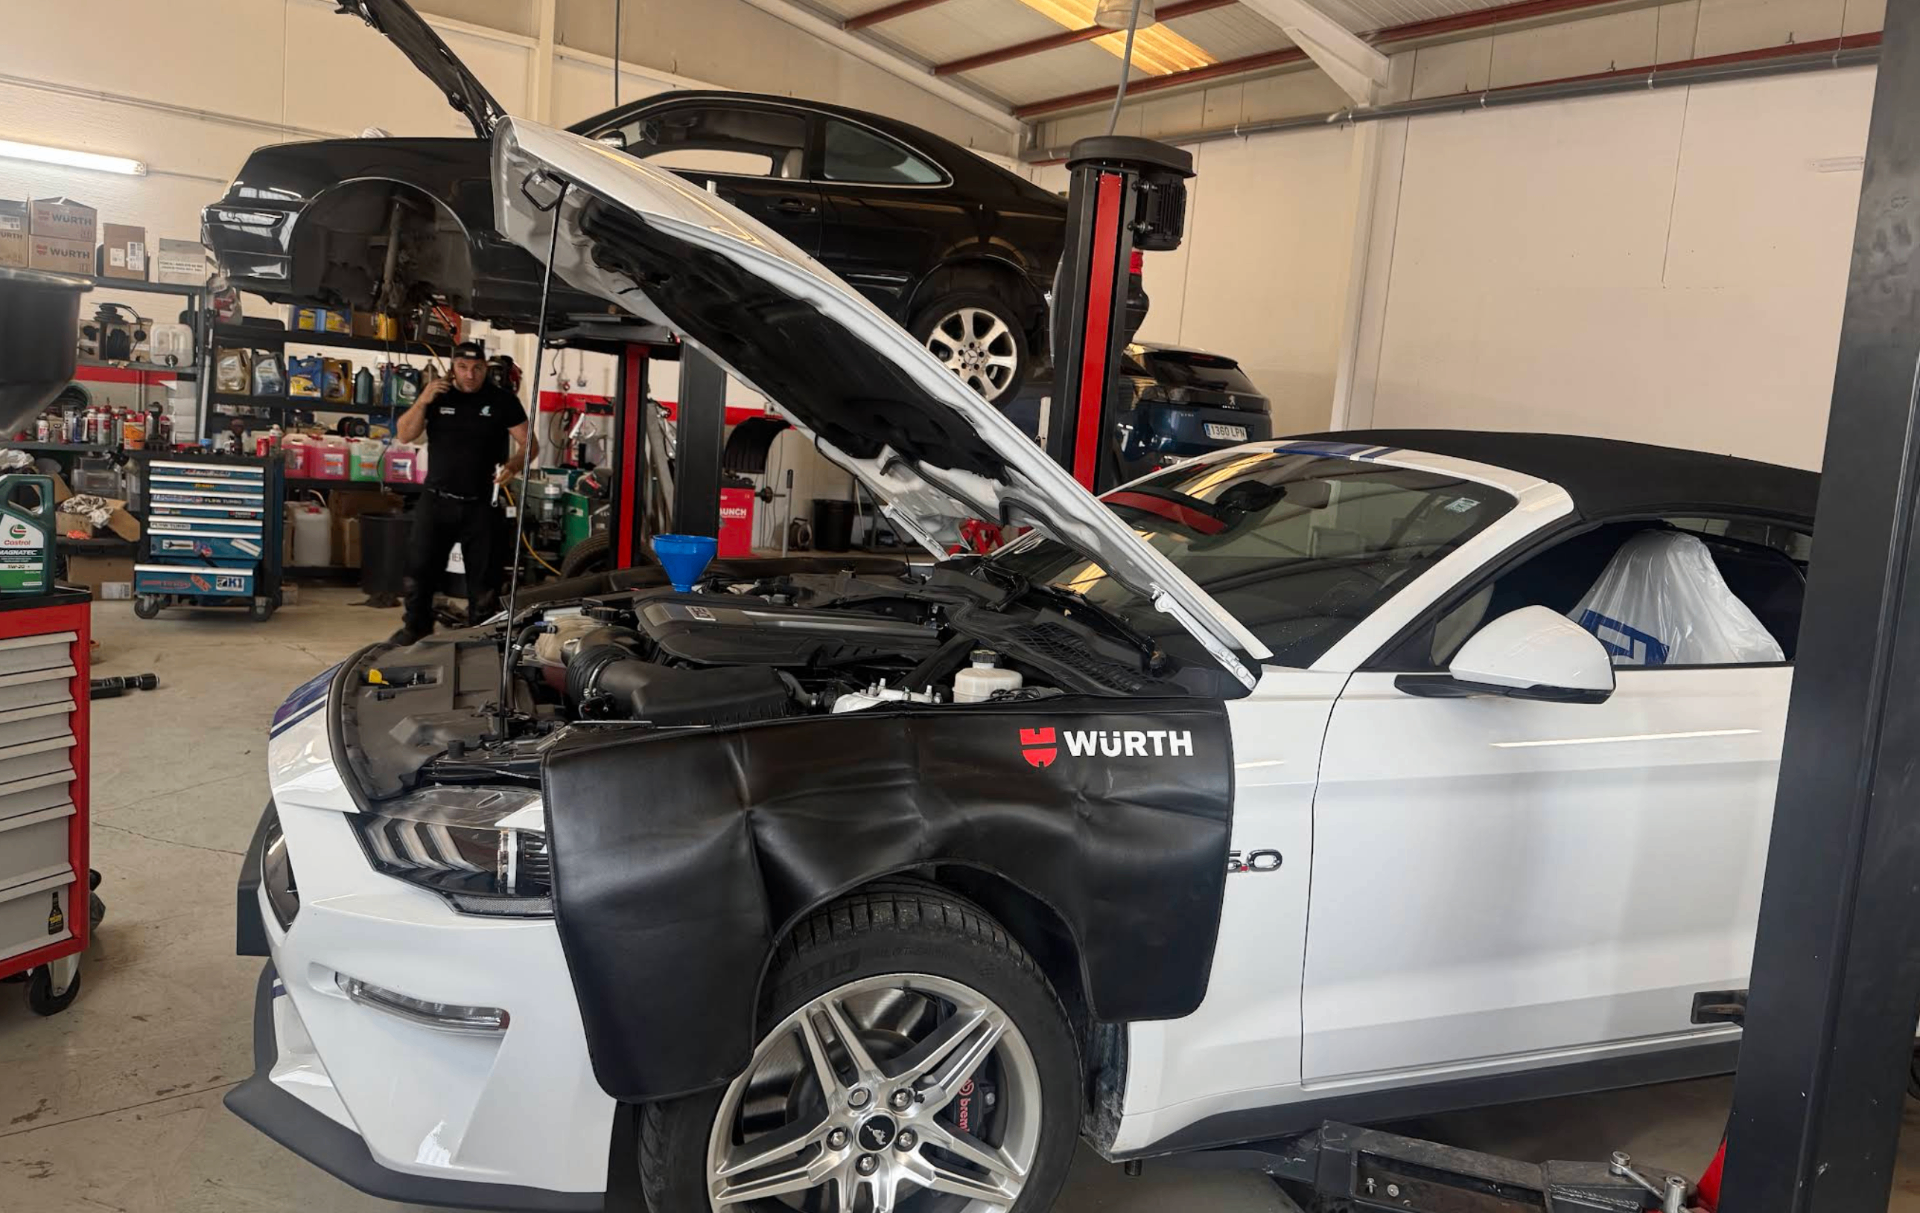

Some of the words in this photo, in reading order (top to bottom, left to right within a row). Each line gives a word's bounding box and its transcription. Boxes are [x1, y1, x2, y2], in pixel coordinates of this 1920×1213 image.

[0, 231, 23, 240] URTH
[1211, 425, 1230, 437] 1360
[720, 507, 747, 516] UNCH
[1063, 730, 1194, 757] WÜRTH
[959, 1098, 971, 1131] brem
